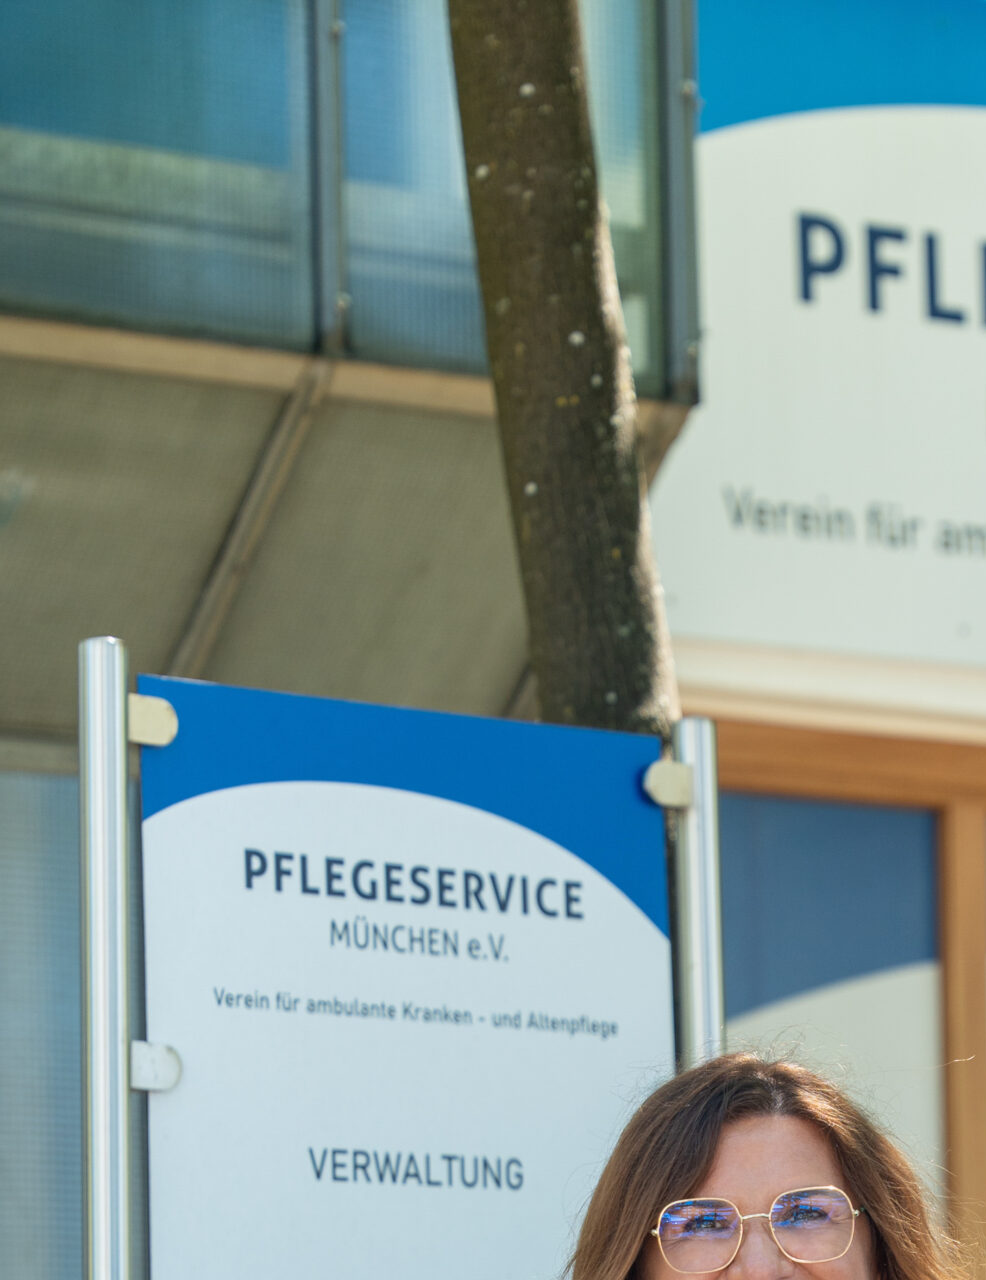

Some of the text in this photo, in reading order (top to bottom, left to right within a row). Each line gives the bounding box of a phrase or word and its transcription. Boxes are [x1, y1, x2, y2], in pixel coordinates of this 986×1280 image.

[244, 848, 585, 921] PFLEGESERVICE
[329, 915, 509, 963] MÜNCHEN e.V.
[213, 986, 270, 1010] Verein
[276, 992, 300, 1012] für
[306, 997, 397, 1020] ambulante
[402, 1002, 473, 1025] Kranken
[492, 1010, 521, 1029] und
[527, 1012, 619, 1041] Altenpflege
[308, 1147, 525, 1191] VERWALTUNG
